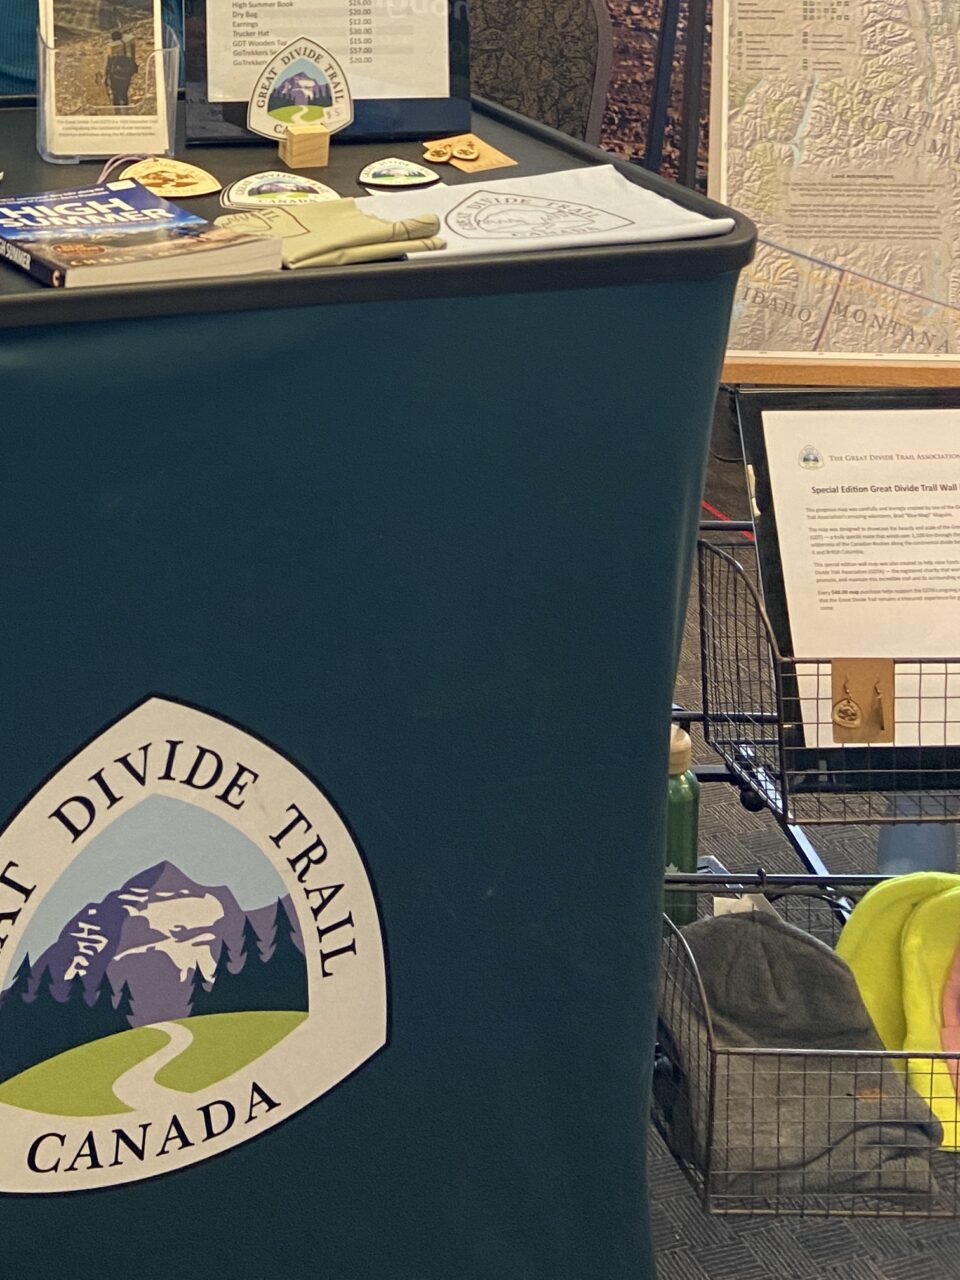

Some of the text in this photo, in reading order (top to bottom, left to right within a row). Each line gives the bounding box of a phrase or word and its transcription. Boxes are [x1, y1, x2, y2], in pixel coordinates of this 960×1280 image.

[245, 11, 258, 19] Bag
[256, 47, 344, 108] GREAT DIVIDE TRAIL
[6, 242, 32, 270] SUMMER
[742, 287, 812, 322] IDAHO
[832, 301, 951, 353] MONTANA
[811, 486, 839, 495] Special
[840, 485, 868, 493] Edition
[921, 484, 938, 492] Trail
[48, 739, 259, 843] DIVIDE
[269, 804, 358, 978] TRAIL
[27, 1080, 281, 1173] CANADA
